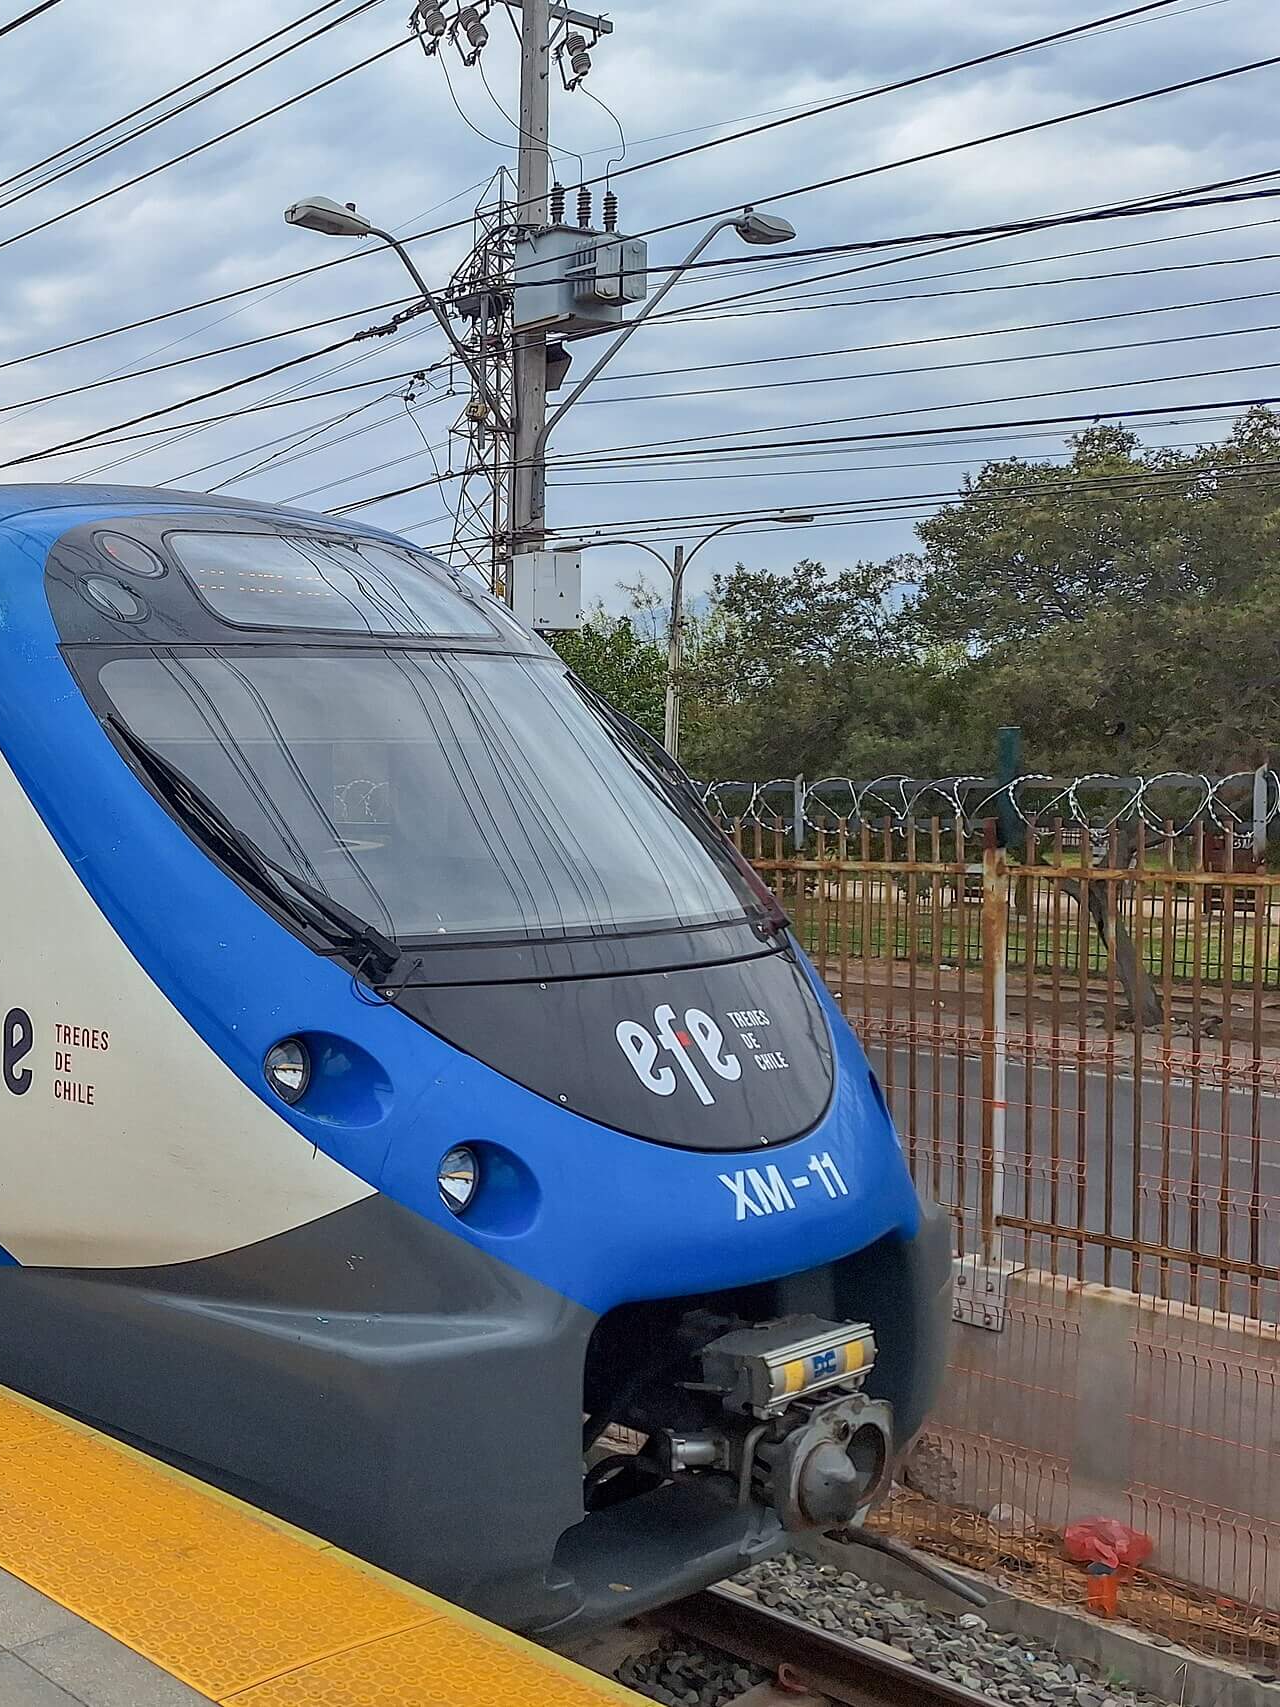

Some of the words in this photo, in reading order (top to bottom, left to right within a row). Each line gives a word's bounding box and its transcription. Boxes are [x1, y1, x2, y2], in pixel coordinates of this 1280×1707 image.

[726, 1009, 770, 1029] TRENES
[55, 1023, 109, 1051] TRENES
[740, 1032, 761, 1050] DE
[55, 1051, 72, 1073] DE
[615, 1004, 742, 1106] efe
[754, 1051, 789, 1071] CHILE
[54, 1079, 95, 1105] CHILE
[717, 1151, 849, 1221] XM-11
